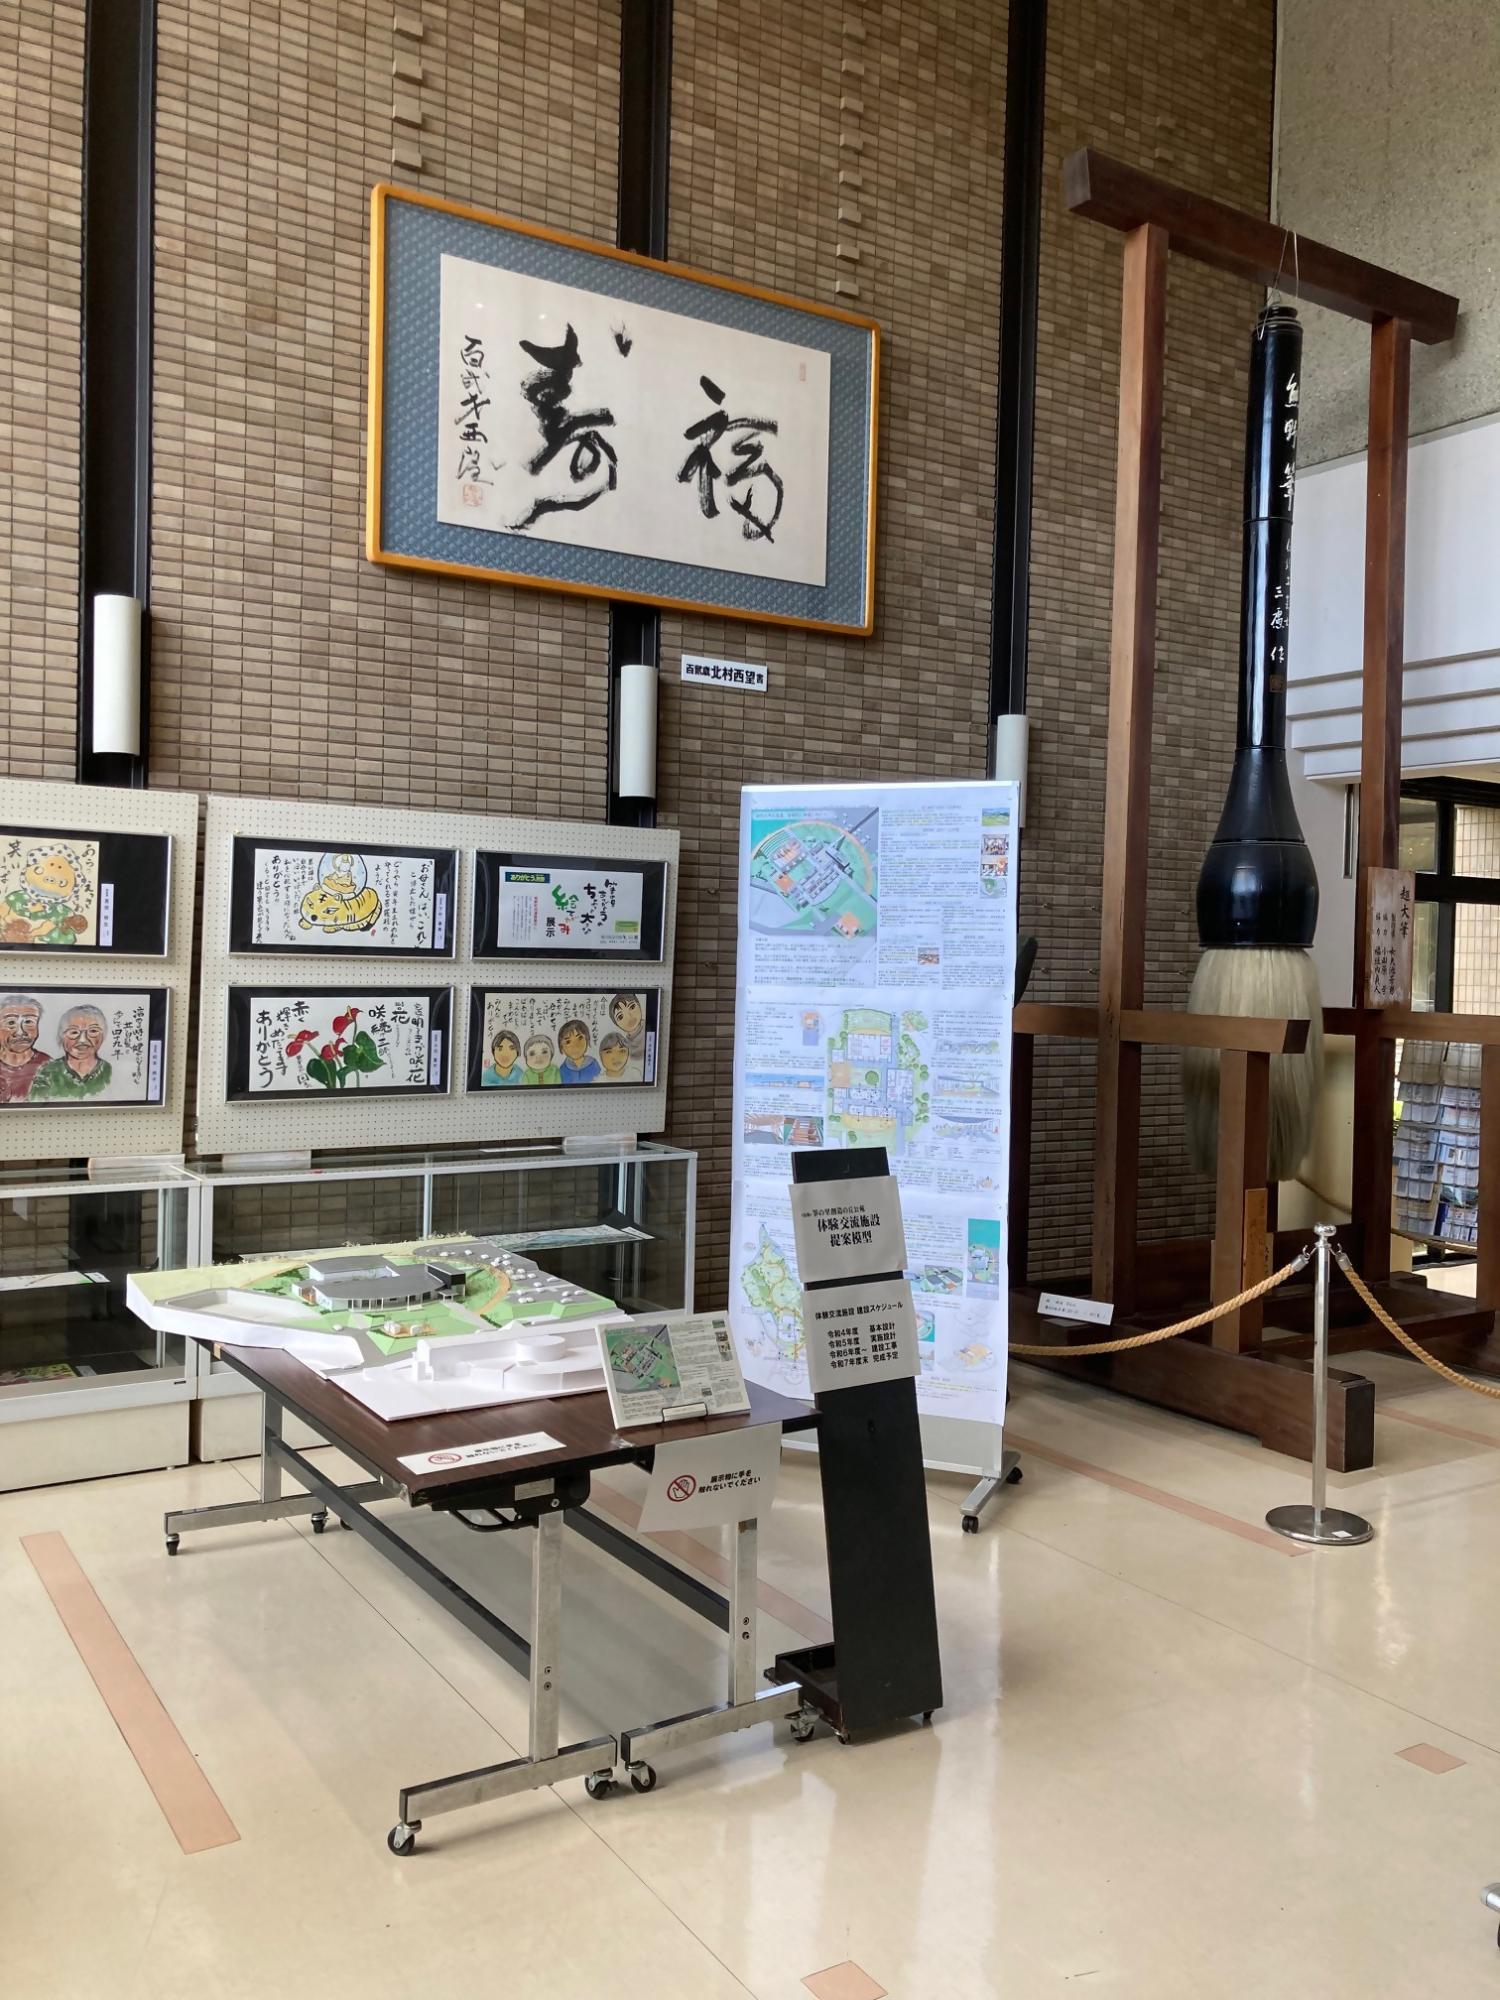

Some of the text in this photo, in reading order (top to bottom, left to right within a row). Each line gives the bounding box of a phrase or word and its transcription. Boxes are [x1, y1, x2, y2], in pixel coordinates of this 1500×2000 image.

[545, 917, 556, 937] 展示
[256, 1009, 273, 1089] ありがとう
[817, 1214, 880, 1233] 体験交流施設
[830, 1230, 873, 1247] 提案模型
[815, 1301, 903, 1320] 体験交流施設 建設スケジュール
[827, 1322, 895, 1338] 令和4年度 基本設計
[828, 1332, 896, 1348] 令和5年度 実施設計
[872, 1342, 897, 1353] 建設工事
[830, 1351, 899, 1369] 令和7年度末 完成予定
[710, 1469, 752, 1483] 展示物に手を
[698, 1477, 761, 1493] 触れないでください
